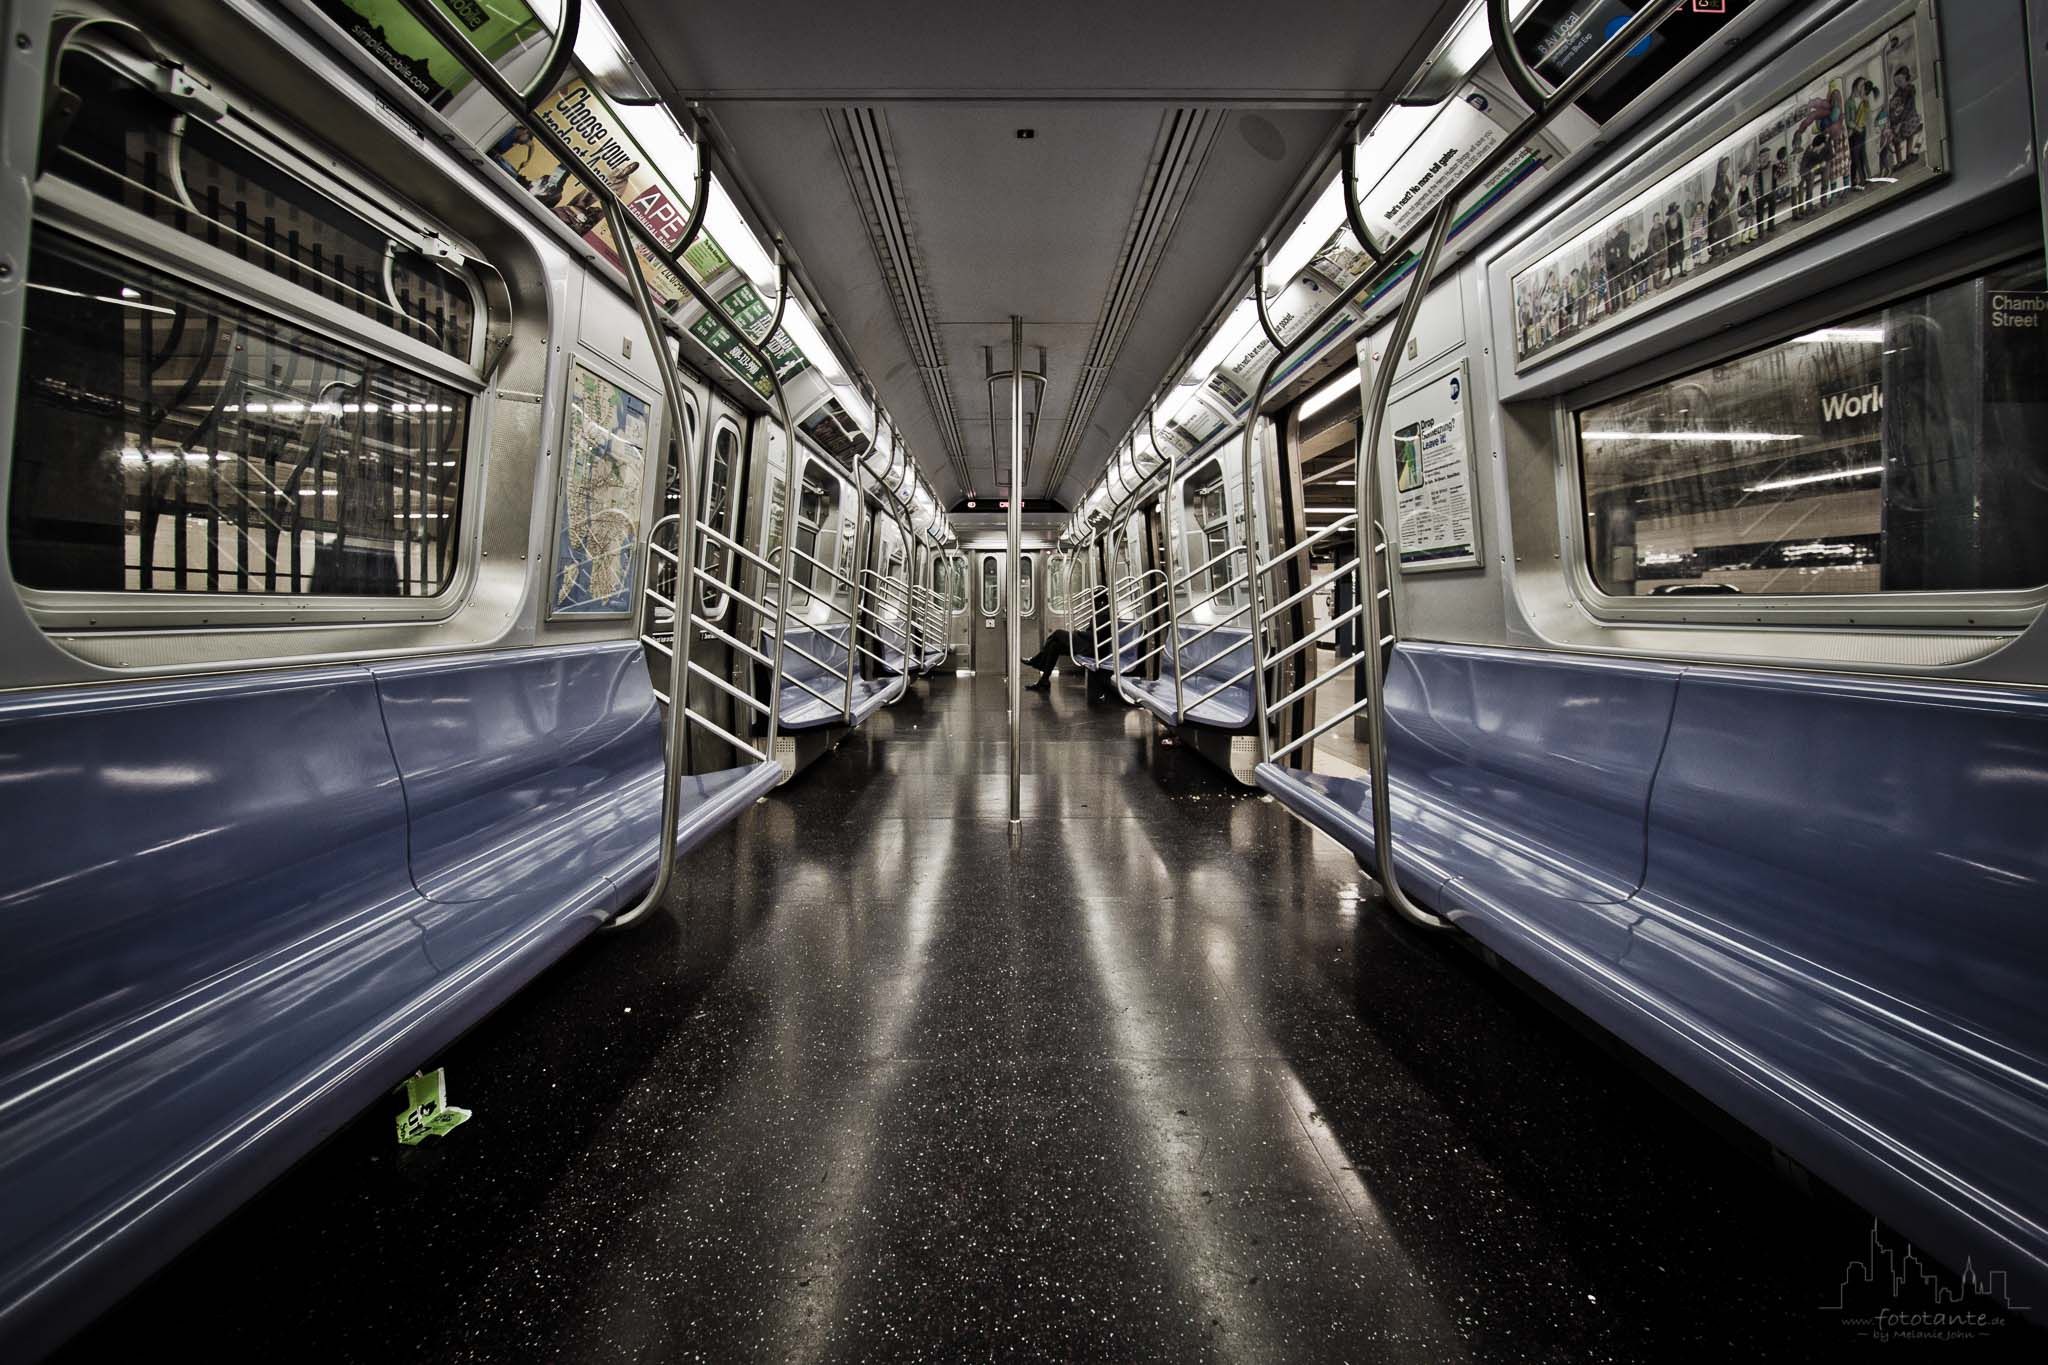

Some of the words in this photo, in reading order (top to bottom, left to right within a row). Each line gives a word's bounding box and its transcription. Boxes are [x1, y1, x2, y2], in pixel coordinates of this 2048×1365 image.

[450, 0, 480, 27] obile
[1554, 11, 1581, 37] Local
[352, 24, 429, 94] simplemobile.com
[556, 87, 607, 145] Choose
[590, 137, 630, 169] your
[1384, 205, 1401, 219] What's
[1399, 191, 1413, 207] next?
[1409, 185, 1420, 194] No
[1418, 172, 1433, 188] more
[1429, 162, 1441, 174] toll
[1439, 148, 1458, 166] gates.
[635, 192, 686, 242] APE
[1992, 311, 2038, 327] Street
[1822, 386, 1884, 422] Worl
[1421, 417, 1434, 429] Drop
[1423, 438, 1439, 450] Leave
